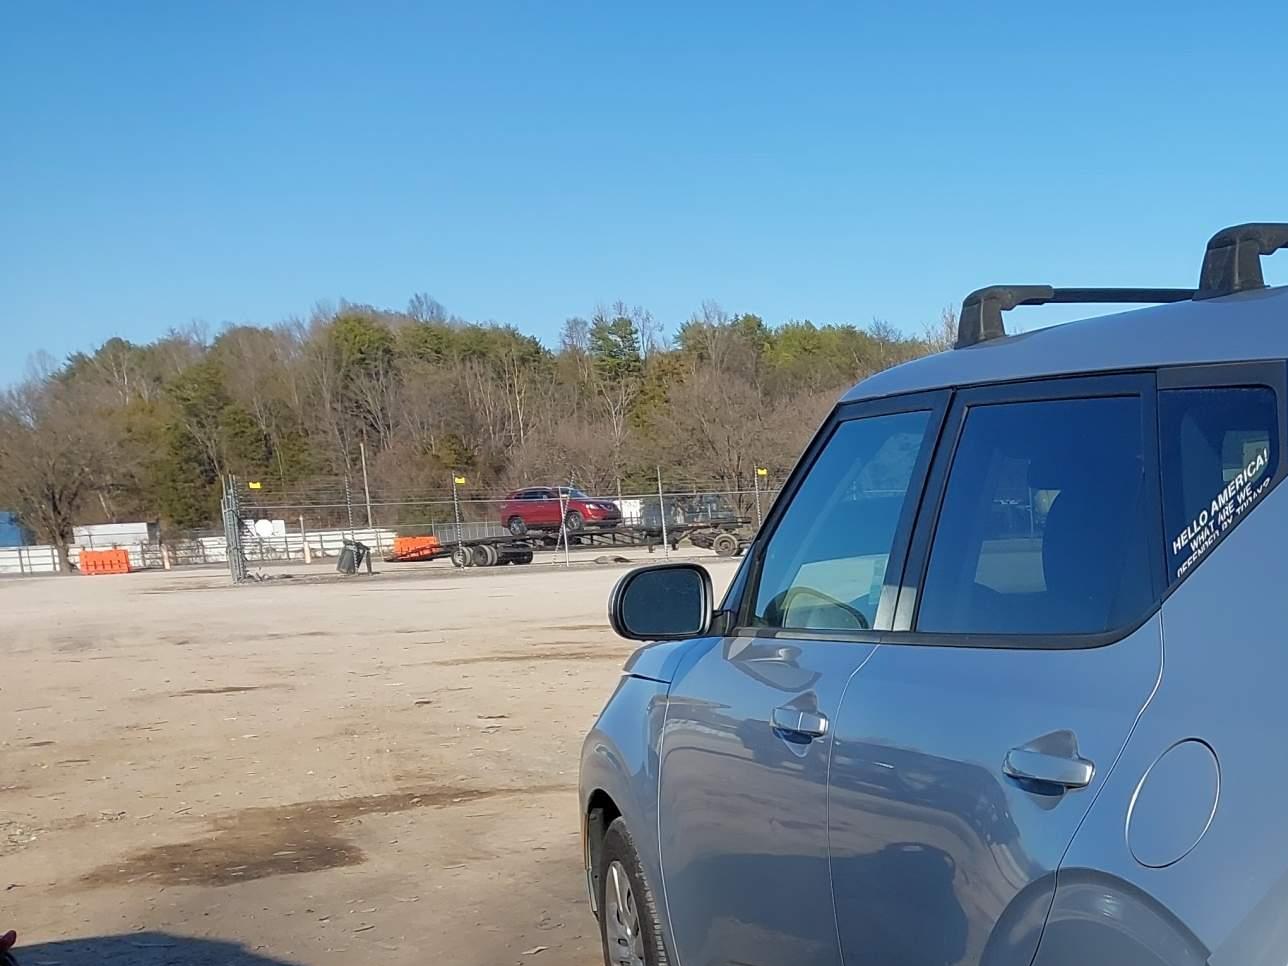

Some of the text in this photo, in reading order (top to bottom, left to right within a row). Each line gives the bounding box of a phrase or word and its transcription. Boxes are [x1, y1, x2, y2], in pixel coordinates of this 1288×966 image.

[1172, 447, 1269, 555] HELLO AMERICA!
[1190, 482, 1253, 551] WHAT ARE WE
